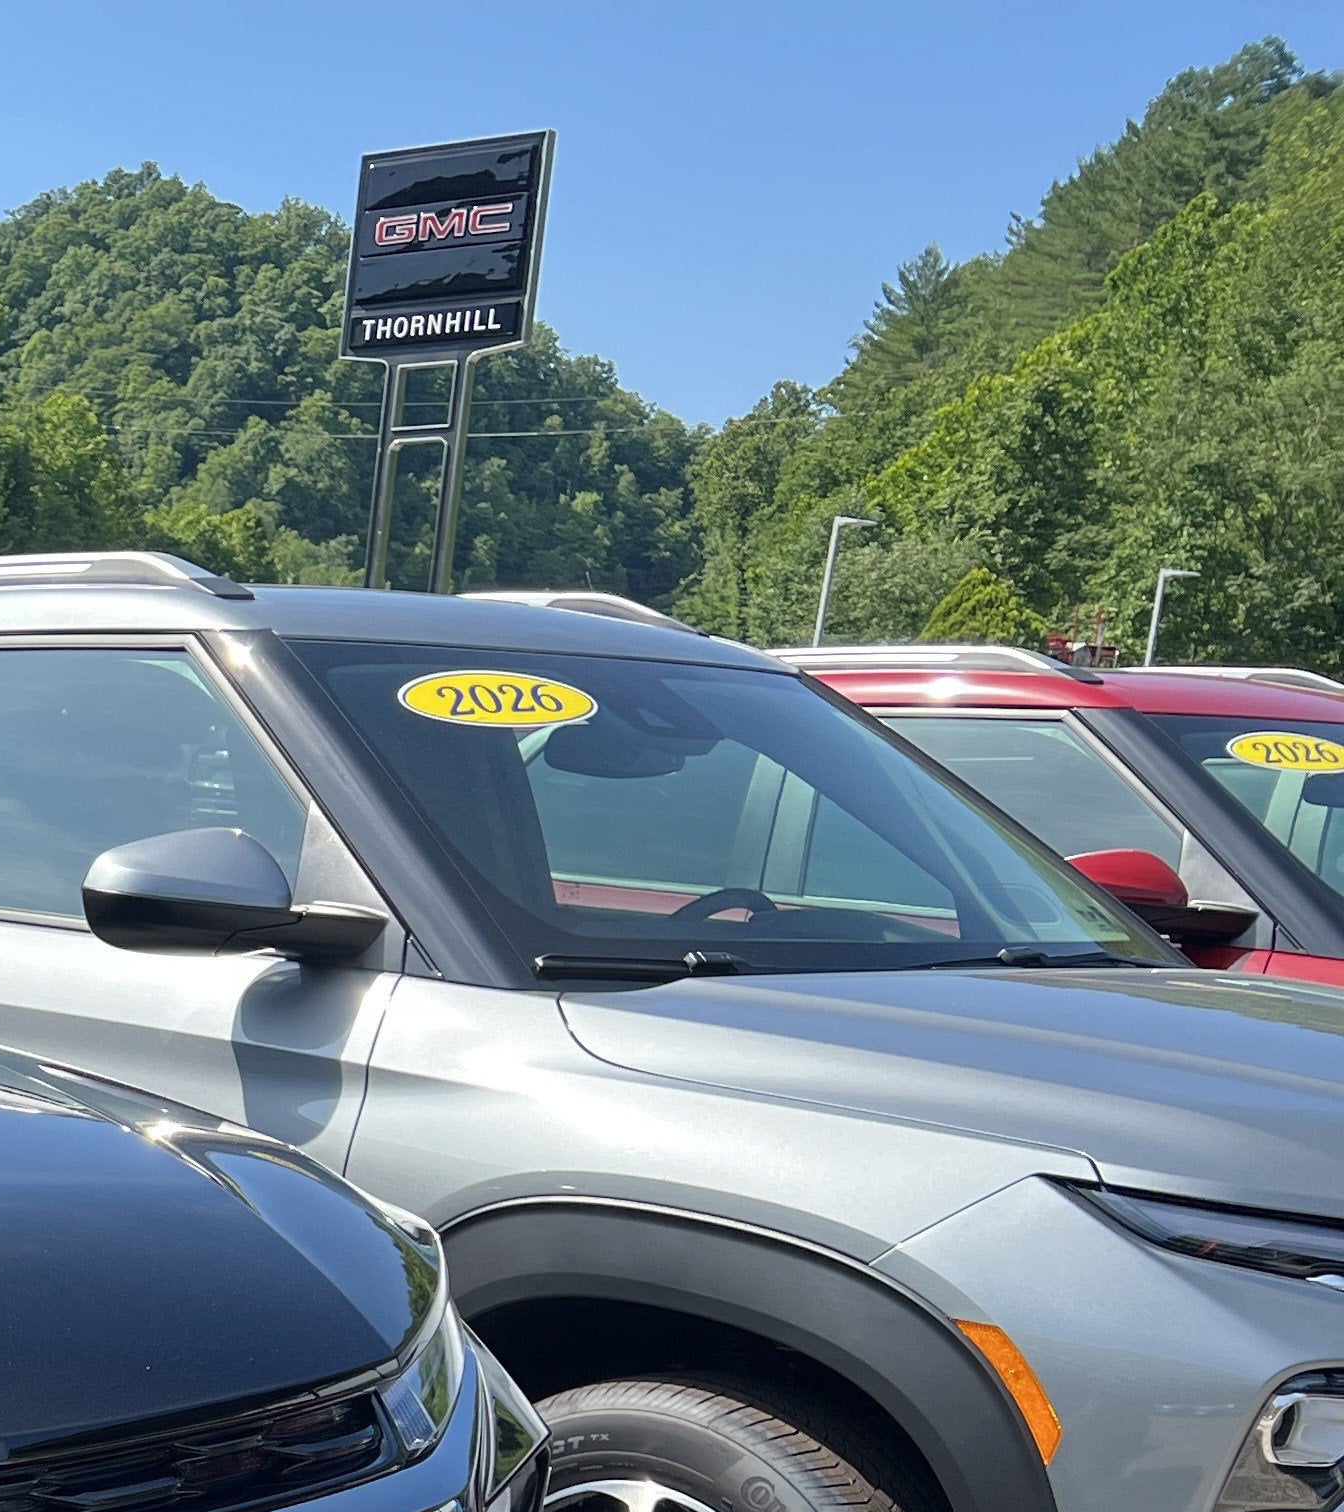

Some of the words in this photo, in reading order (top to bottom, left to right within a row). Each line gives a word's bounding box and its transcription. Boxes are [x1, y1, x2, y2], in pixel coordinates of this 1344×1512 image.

[374, 202, 514, 247] GMC
[362, 308, 502, 341] THORNHILL
[436, 683, 564, 717] 2026
[1252, 741, 1339, 763] 2026
